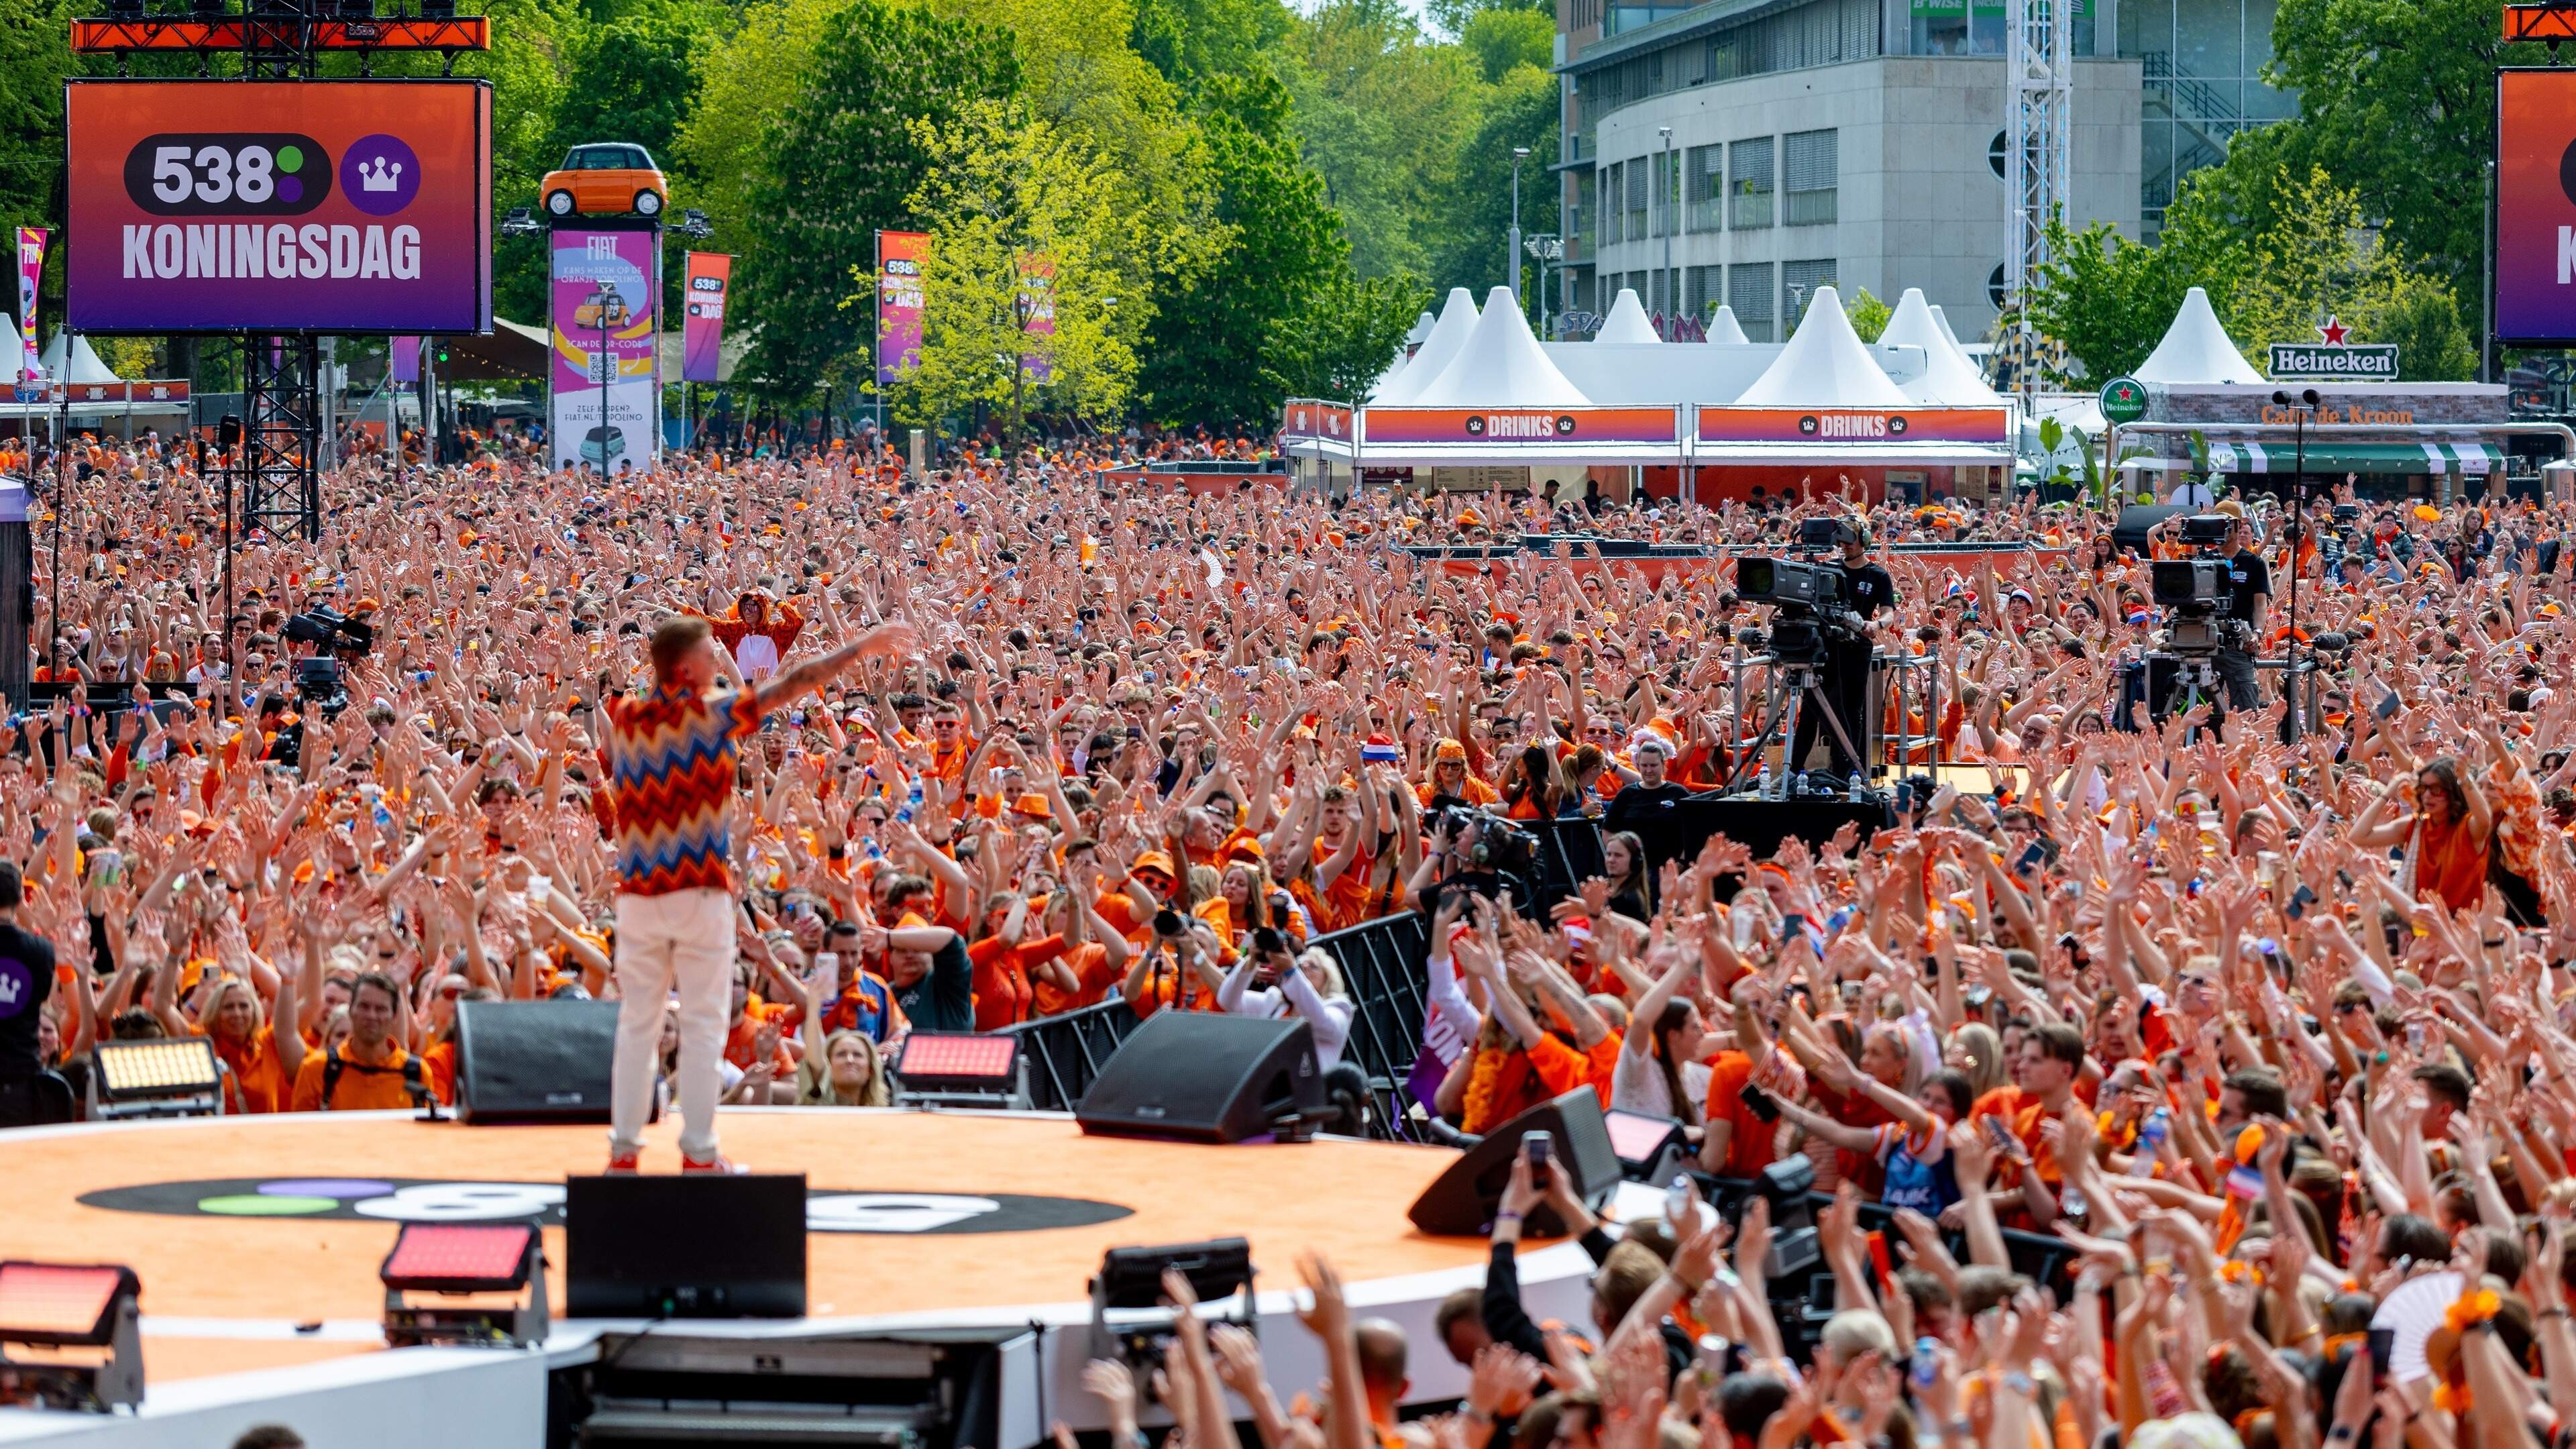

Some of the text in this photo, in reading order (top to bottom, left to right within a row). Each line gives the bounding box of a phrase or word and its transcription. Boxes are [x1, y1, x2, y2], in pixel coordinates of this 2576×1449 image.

[153, 146, 274, 204] 538
[123, 223, 421, 280] KONINGSDAG
[587, 235, 619, 261] FIAT
[564, 266, 585, 274] KANS
[616, 266, 629, 274] OP
[632, 266, 643, 274] DE
[888, 260, 914, 274] 538
[561, 275, 594, 283] ORANJE
[694, 278, 716, 290] 538
[701, 304, 722, 319] DAG
[566, 340, 588, 348] SCAN
[590, 340, 600, 348] DE
[2106, 403, 2143, 411] Heineken
[2314, 405, 2341, 425] de
[2349, 405, 2414, 425] Kroon
[1488, 415, 1554, 437] DRINKS
[1820, 415, 1886, 437] DRINKS
